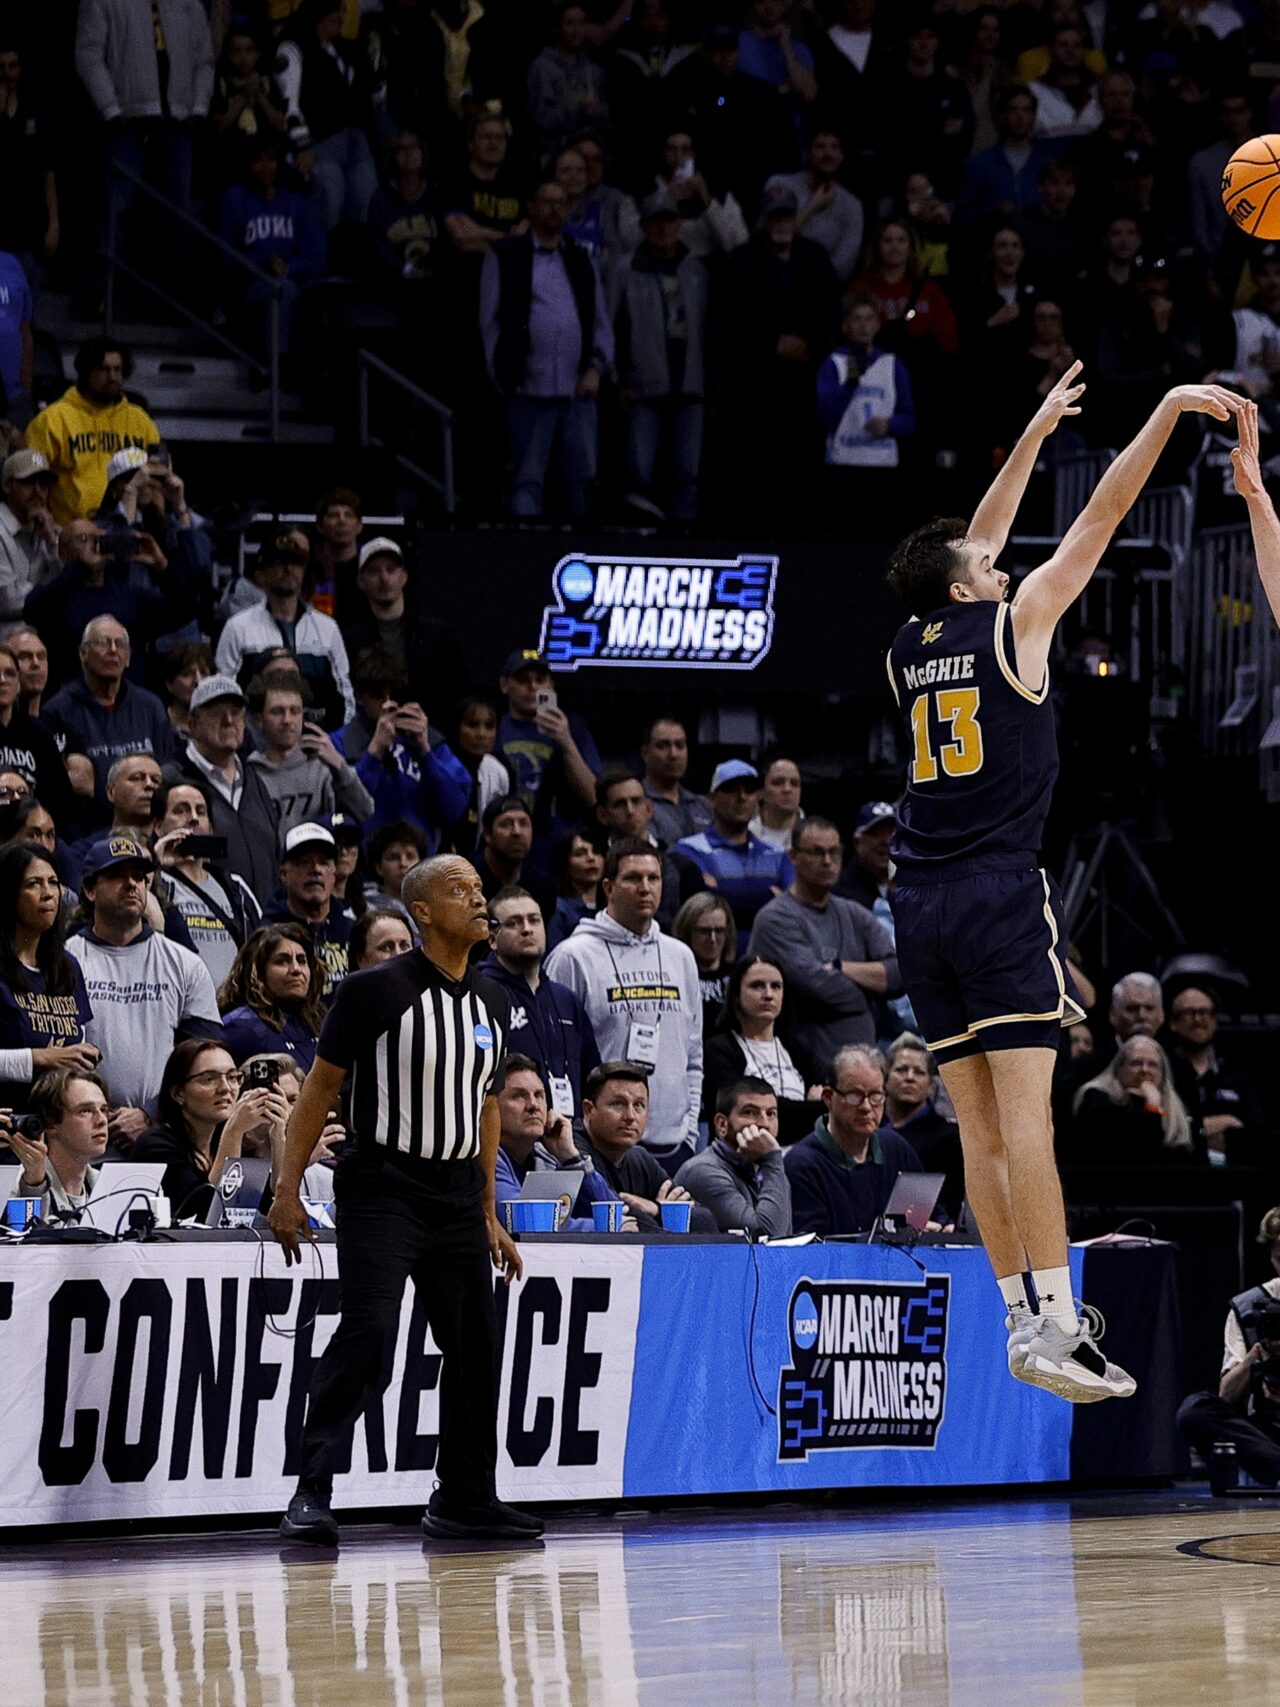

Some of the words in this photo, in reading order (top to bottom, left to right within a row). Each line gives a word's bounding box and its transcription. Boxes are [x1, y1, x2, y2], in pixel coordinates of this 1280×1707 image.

[594, 565, 713, 607] MARCH
[608, 606, 768, 650] MADNESS
[902, 654, 975, 690] McGHIE
[911, 686, 984, 784] 13
[28, 1010, 79, 1037] TRITONS
[818, 1294, 900, 1355] MARCH
[38, 1277, 611, 1487] CONFEECE
[831, 1359, 943, 1420] MADNESS
